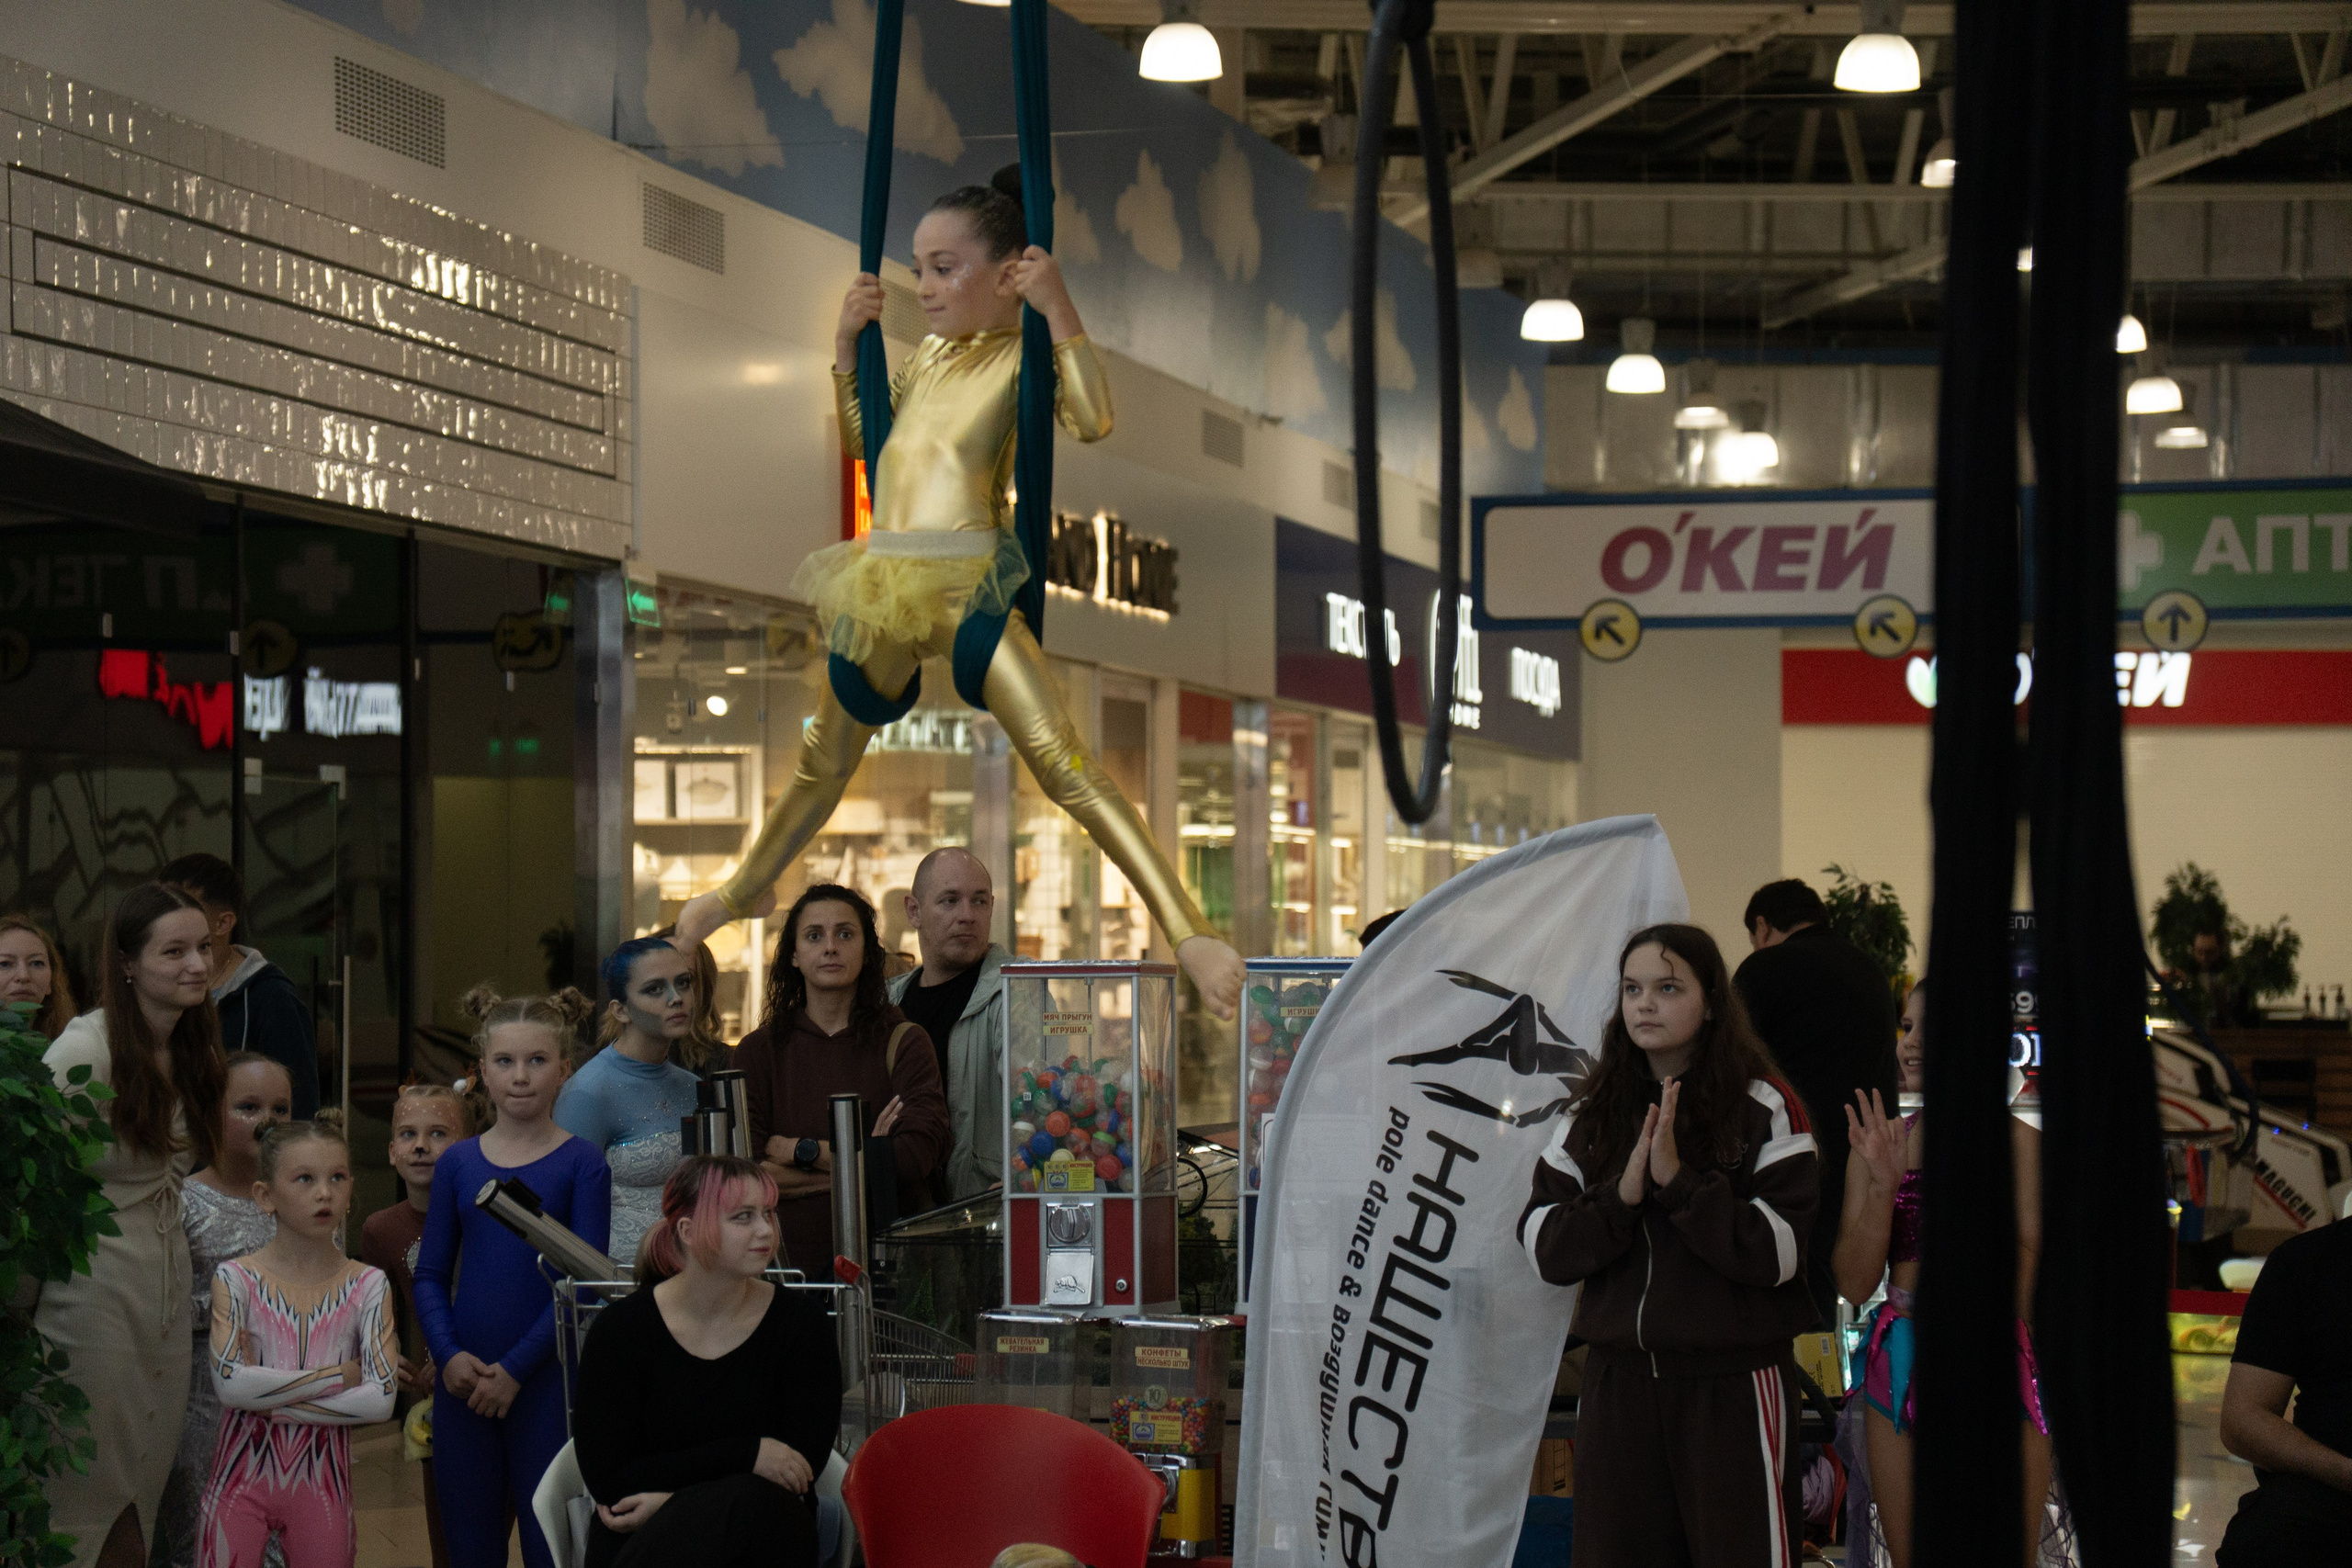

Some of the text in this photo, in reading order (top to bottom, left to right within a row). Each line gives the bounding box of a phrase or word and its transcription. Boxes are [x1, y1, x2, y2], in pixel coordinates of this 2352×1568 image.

[1600, 508, 1896, 594] О'КЕЙ
[2191, 513, 2352, 575] АПТ
[1050, 1026, 1088, 1034] ИГРУШКА
[1375, 1106, 1410, 1174] pole
[1347, 1179, 1389, 1270] dance
[1339, 1274, 1362, 1298] &
[1141, 1348, 1182, 1357] КОНФЕТЫ
